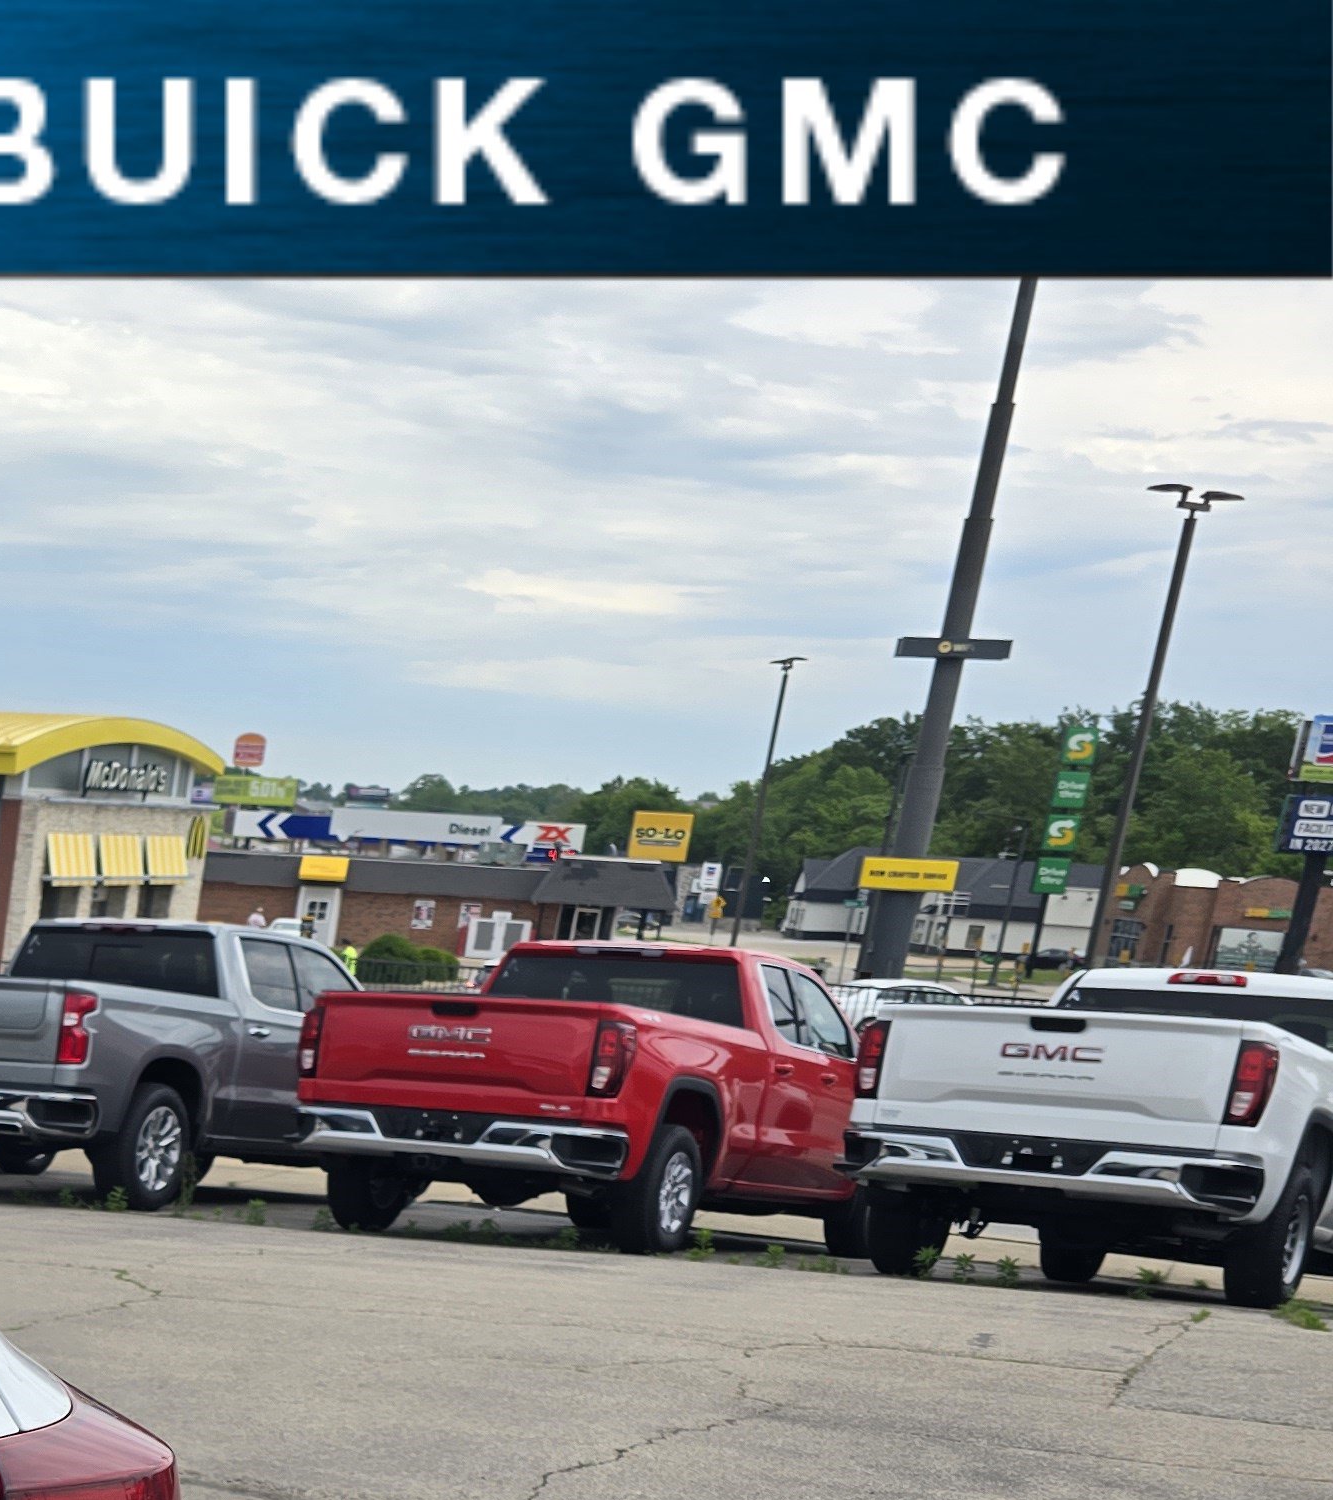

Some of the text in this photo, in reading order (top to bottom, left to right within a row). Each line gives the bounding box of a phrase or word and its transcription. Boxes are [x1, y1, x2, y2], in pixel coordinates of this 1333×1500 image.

[85, 760, 167, 793] McDonald's
[448, 822, 491, 836] Diesel
[636, 827, 686, 840] SO-LO
[408, 1024, 493, 1044] GMC
[1000, 1042, 1104, 1064] GMC
